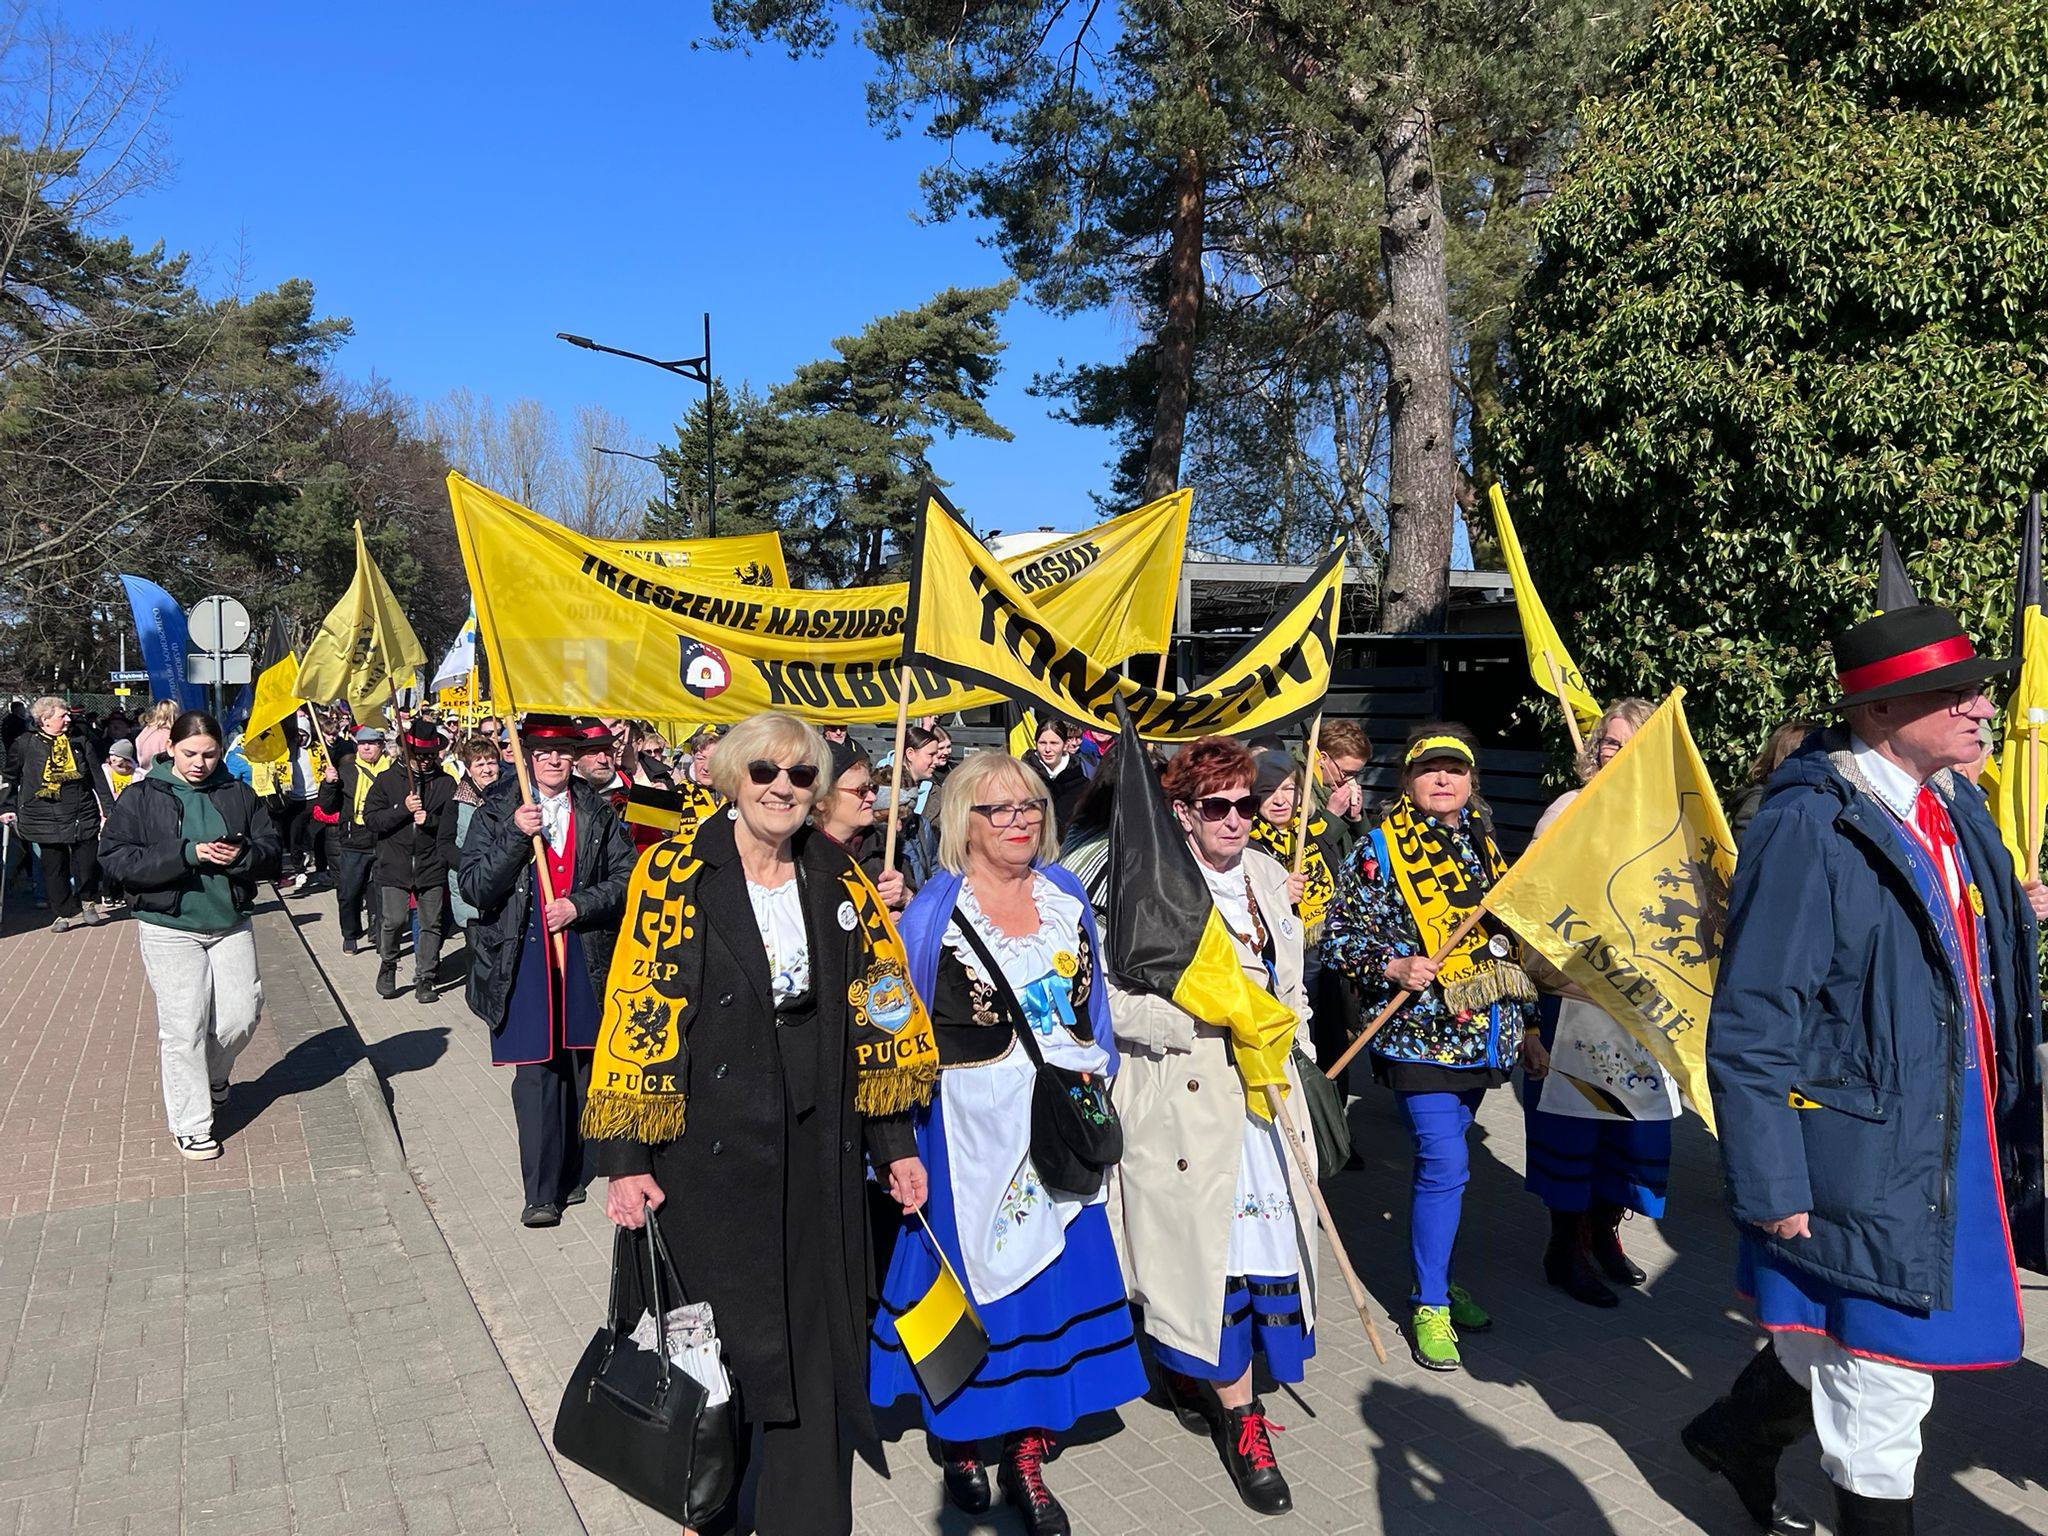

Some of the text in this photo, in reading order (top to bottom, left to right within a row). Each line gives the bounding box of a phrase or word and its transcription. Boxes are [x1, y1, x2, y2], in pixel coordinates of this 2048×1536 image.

[765, 606, 906, 639] KASZUBS
[752, 656, 977, 709] KOLBUD
[632, 959, 679, 981] ZKP
[1441, 959, 1496, 984] KASZËB
[1546, 904, 1696, 1043] KASZËBË
[856, 1032, 933, 1066] PUCK
[606, 1071, 677, 1092] PUCK
